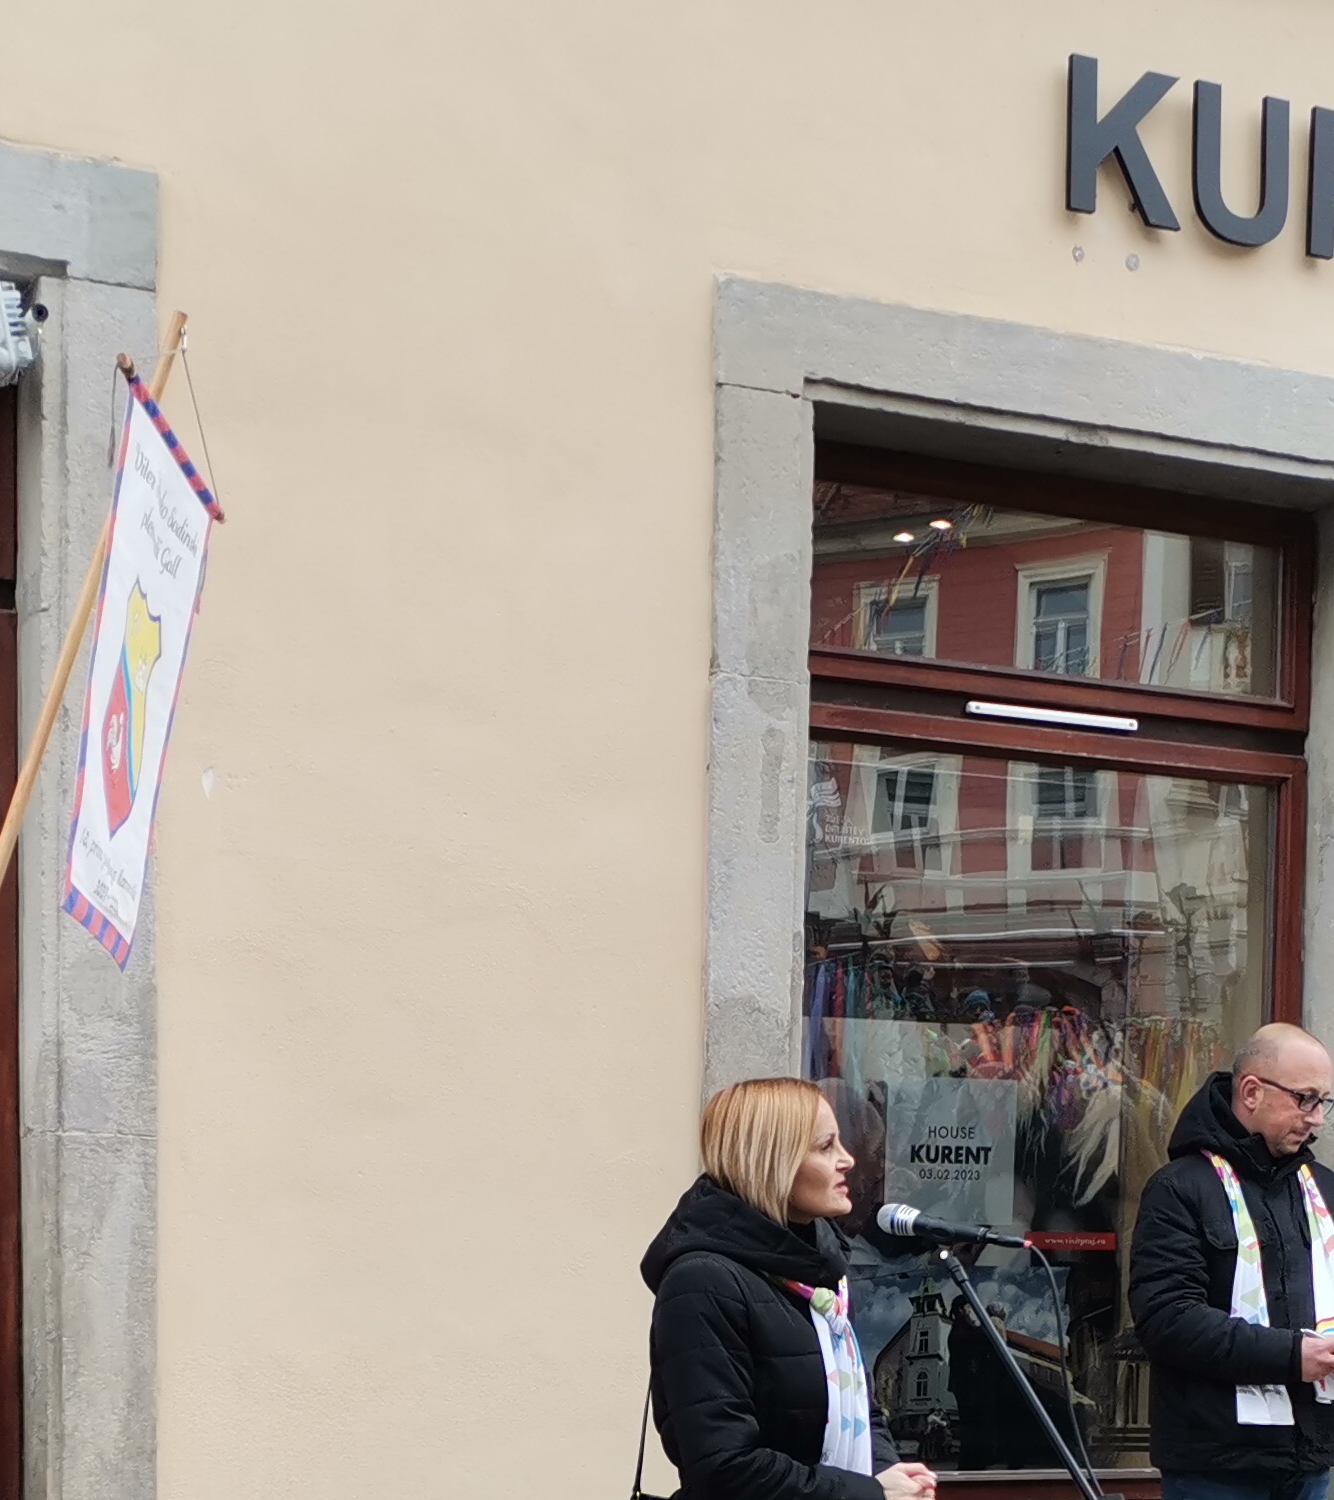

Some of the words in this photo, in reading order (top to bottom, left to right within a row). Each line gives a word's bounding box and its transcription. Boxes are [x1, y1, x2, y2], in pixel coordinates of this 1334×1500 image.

[928, 1126, 975, 1139] HOUSE
[910, 1144, 992, 1165] KURENT
[919, 1169, 981, 1181] 03.02.2023
